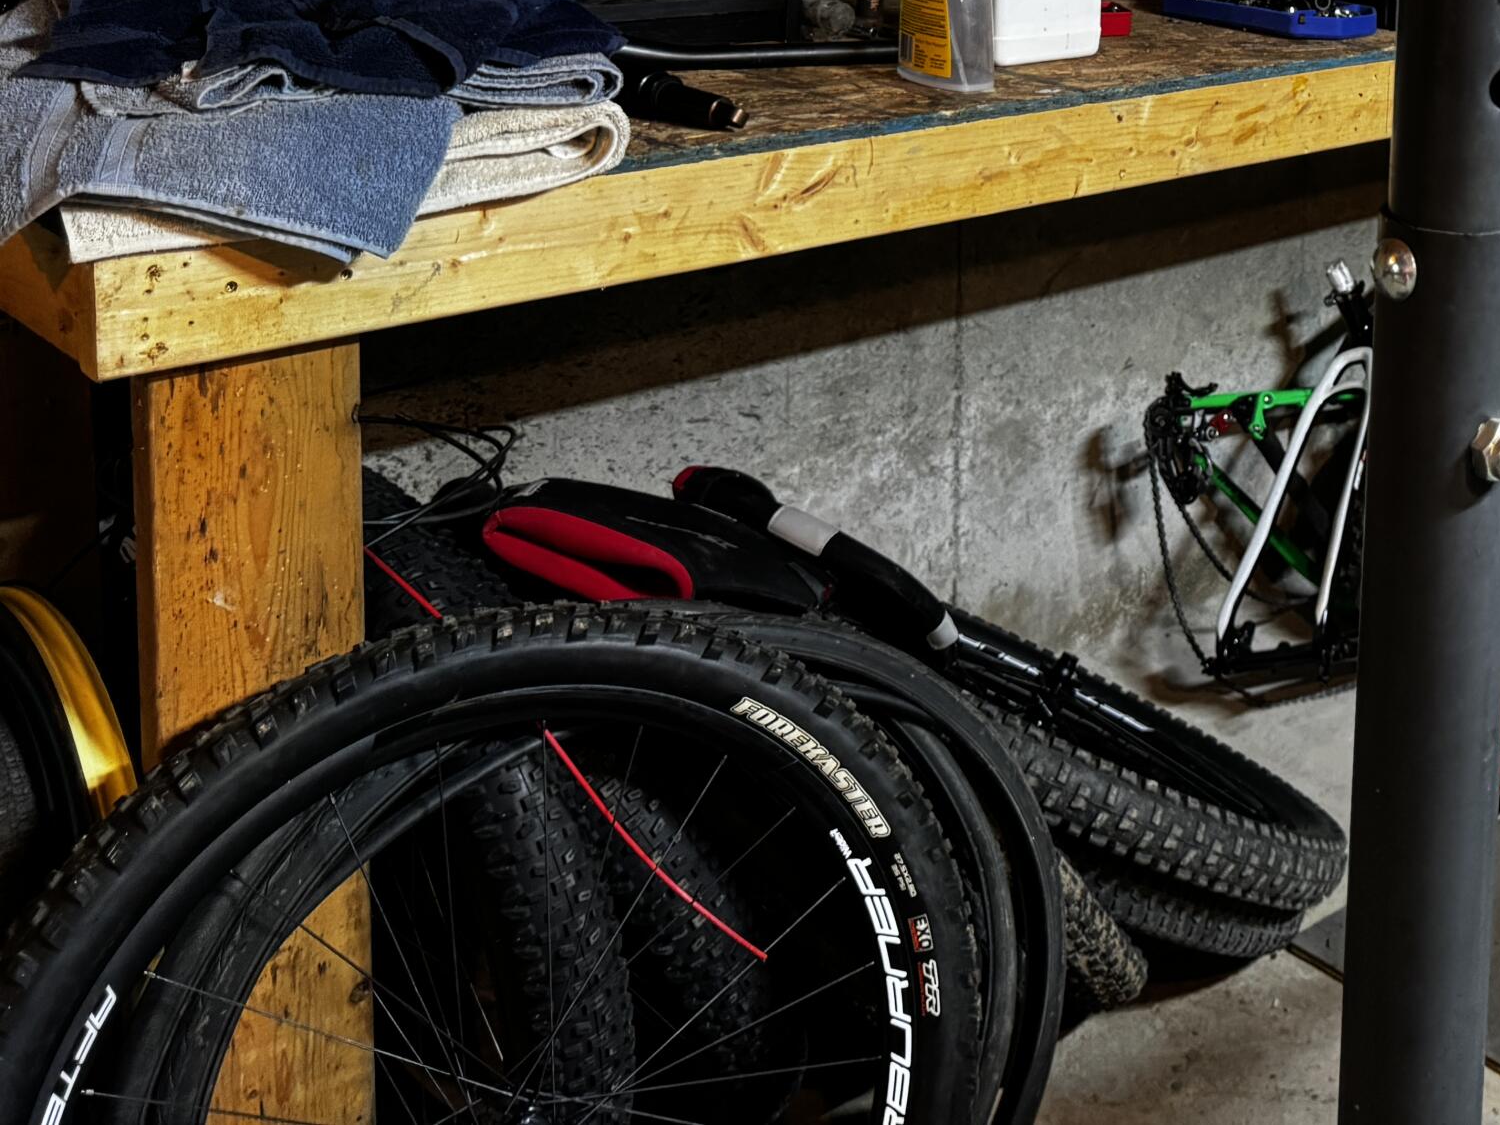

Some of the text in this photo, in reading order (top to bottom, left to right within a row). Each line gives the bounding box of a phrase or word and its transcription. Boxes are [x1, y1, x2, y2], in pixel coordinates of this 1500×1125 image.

[730, 697, 891, 839] FOREKASTER
[914, 915, 931, 949] EXO
[922, 958, 941, 1018] TR
